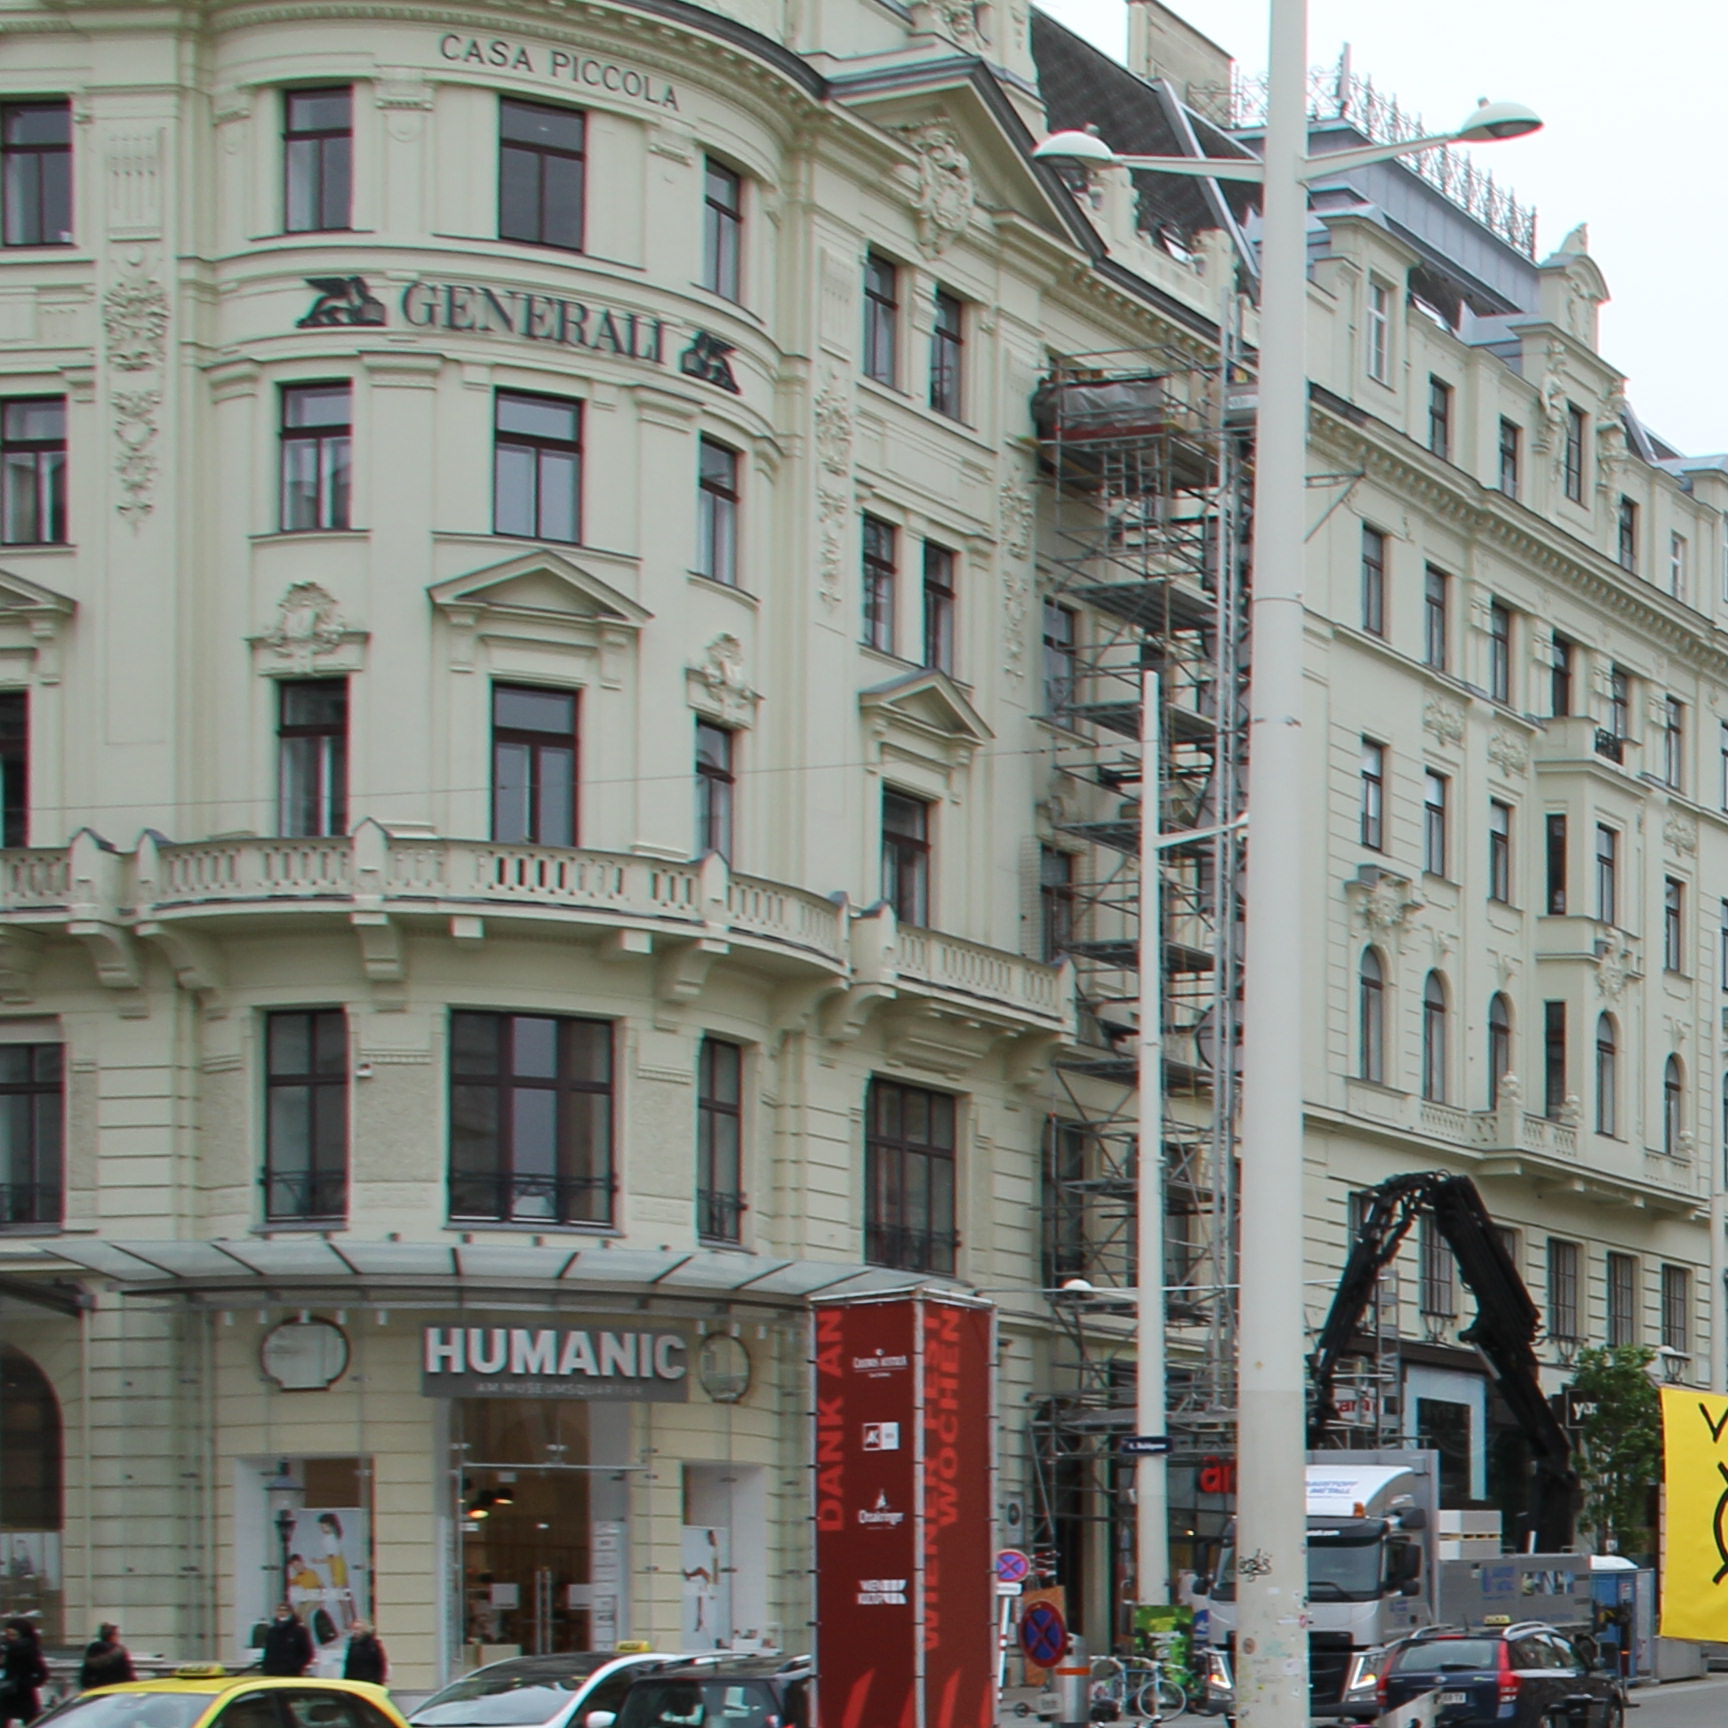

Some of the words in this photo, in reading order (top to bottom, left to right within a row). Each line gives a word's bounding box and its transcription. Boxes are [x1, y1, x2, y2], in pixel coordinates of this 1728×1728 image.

[440, 34, 535, 73] CASA
[550, 50, 681, 112] PICCOLA
[401, 280, 667, 366] GENERALI
[425, 1326, 687, 1380] HUMANIC
[817, 1310, 843, 1378] AN
[937, 1309, 961, 1528] WOCHEN
[817, 1396, 844, 1531] DANK
